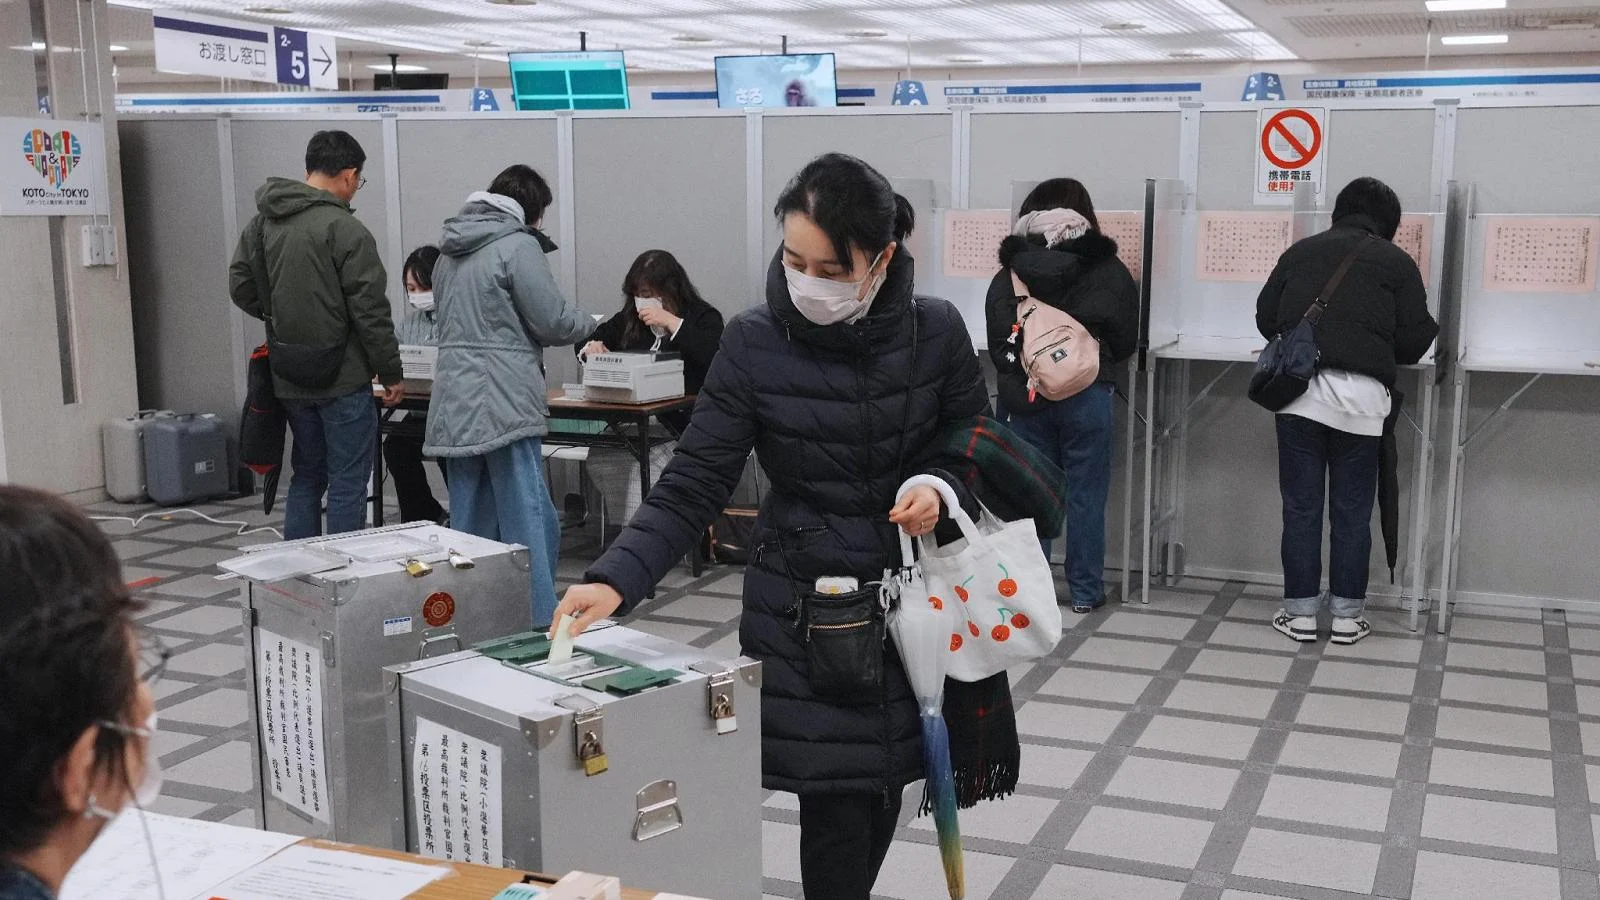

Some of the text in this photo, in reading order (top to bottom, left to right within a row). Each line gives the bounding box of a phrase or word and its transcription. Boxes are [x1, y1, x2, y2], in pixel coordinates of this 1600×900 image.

[280, 34, 291, 47] 2-
[199, 41, 266, 66] お渡し窓口
[291, 50, 306, 80] 5
[23, 128, 81, 155] SPORTS
[1268, 170, 1312, 181] 携帯電話
[22, 188, 46, 198] KOTO
[61, 188, 89, 198] TOKYO
